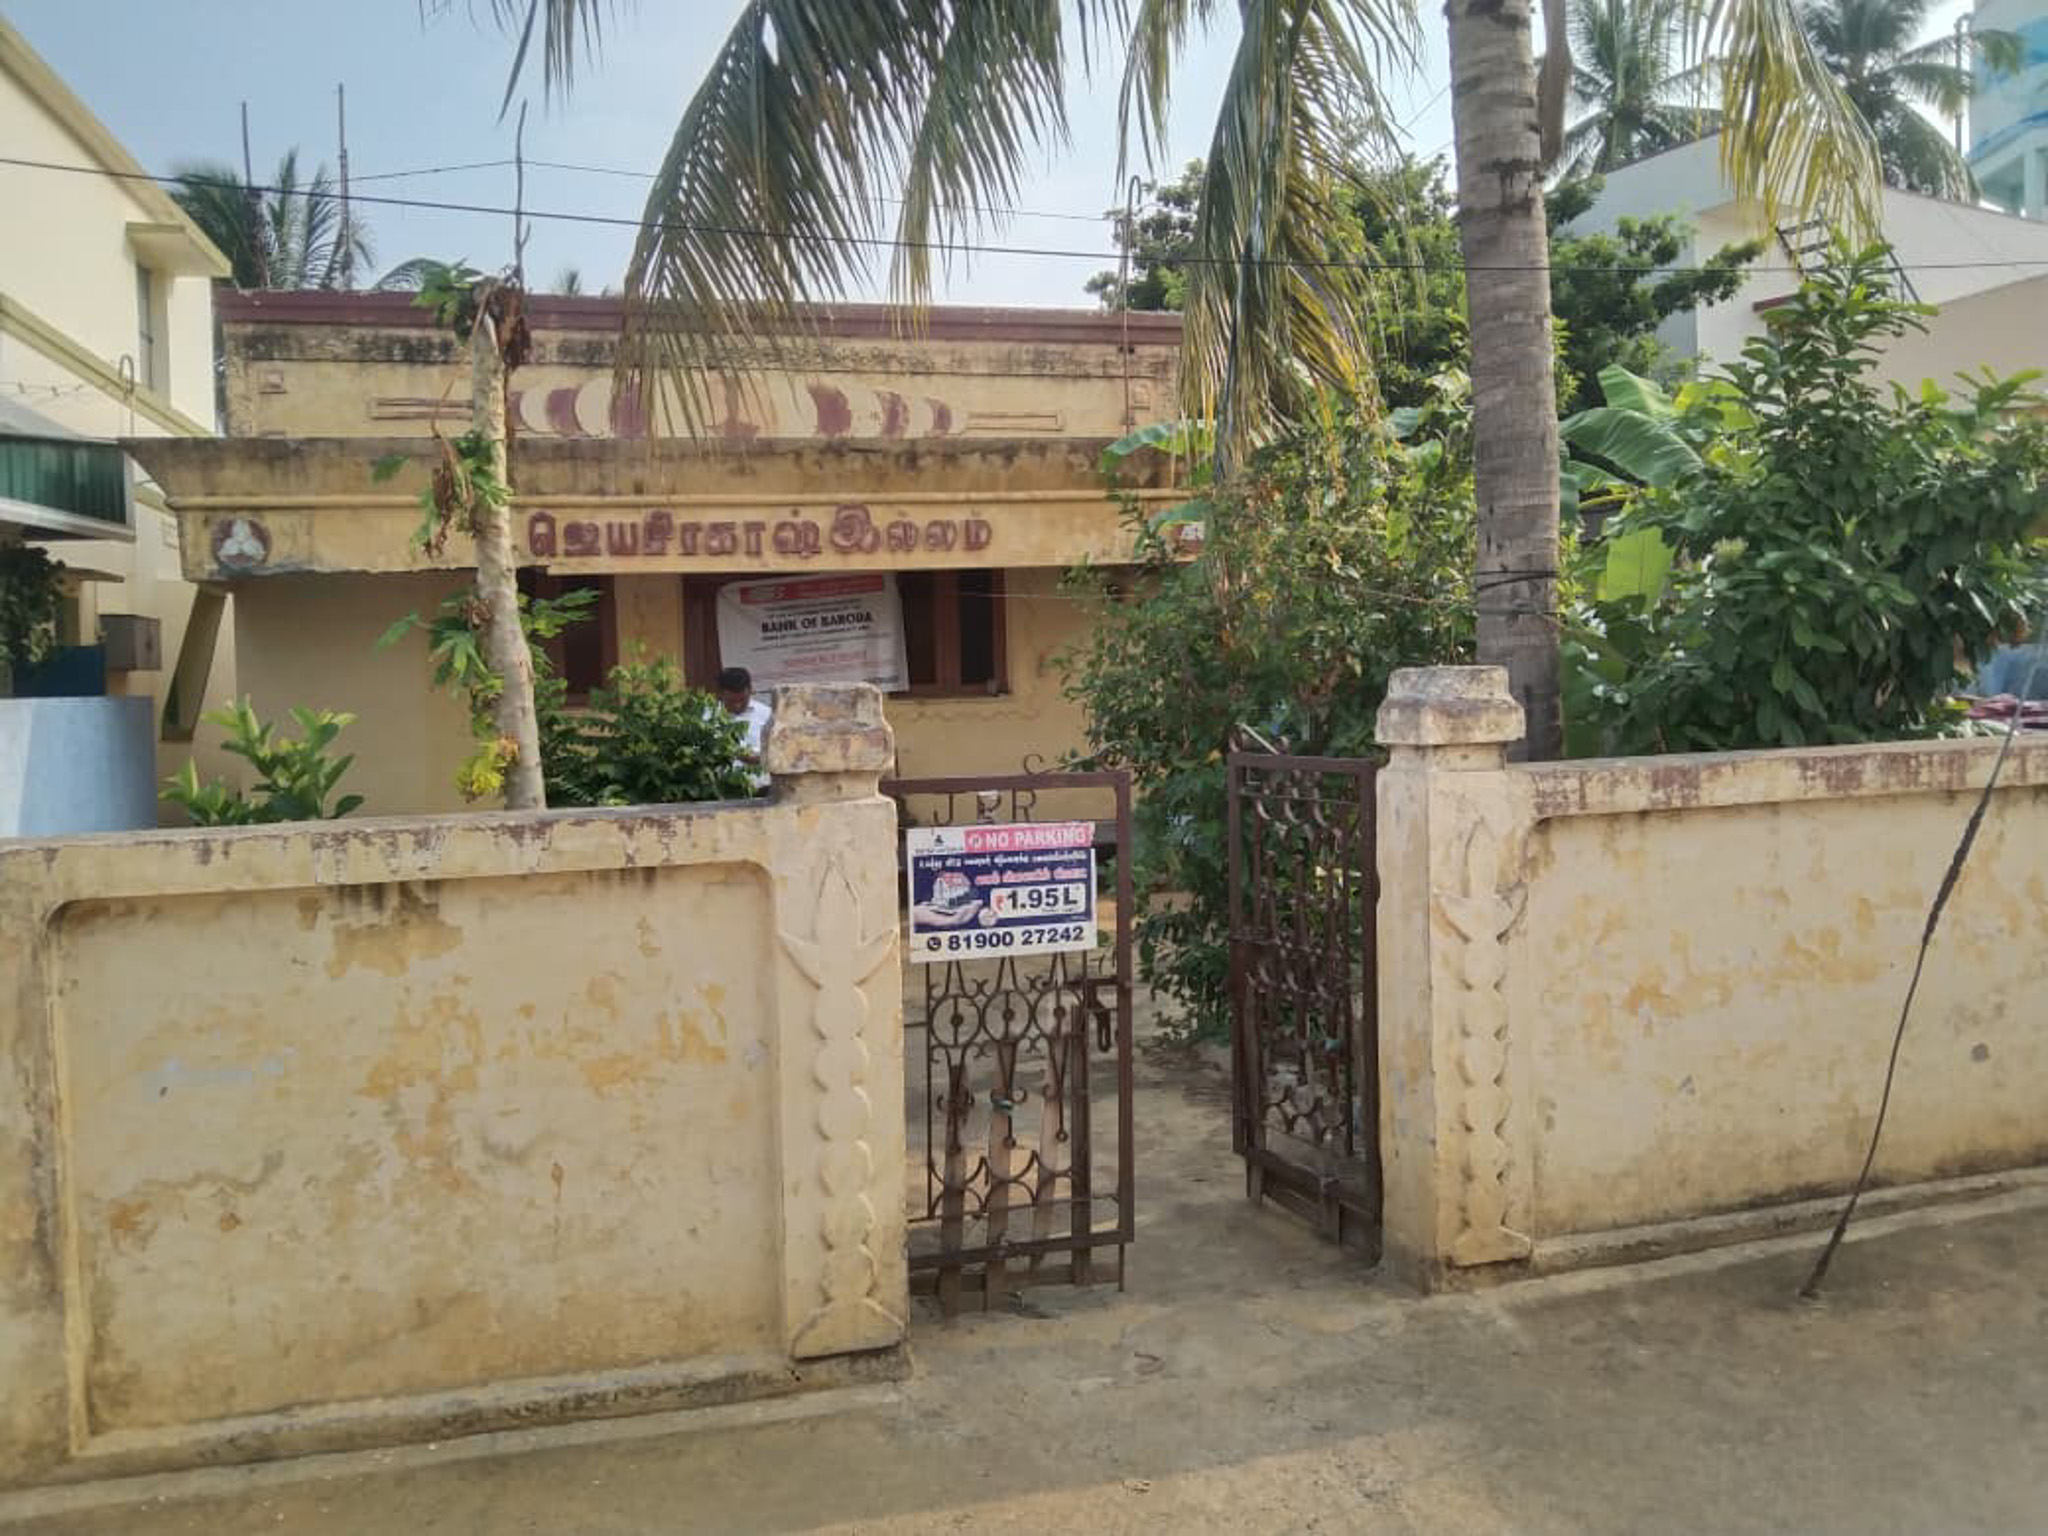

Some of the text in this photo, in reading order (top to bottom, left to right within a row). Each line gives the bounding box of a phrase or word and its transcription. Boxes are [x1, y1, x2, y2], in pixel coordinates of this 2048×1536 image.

[761, 618, 797, 634] BANK
[821, 611, 874, 627] BARODA
[986, 826, 1086, 847] NO PARKING
[948, 926, 1085, 951] 81900 27242
